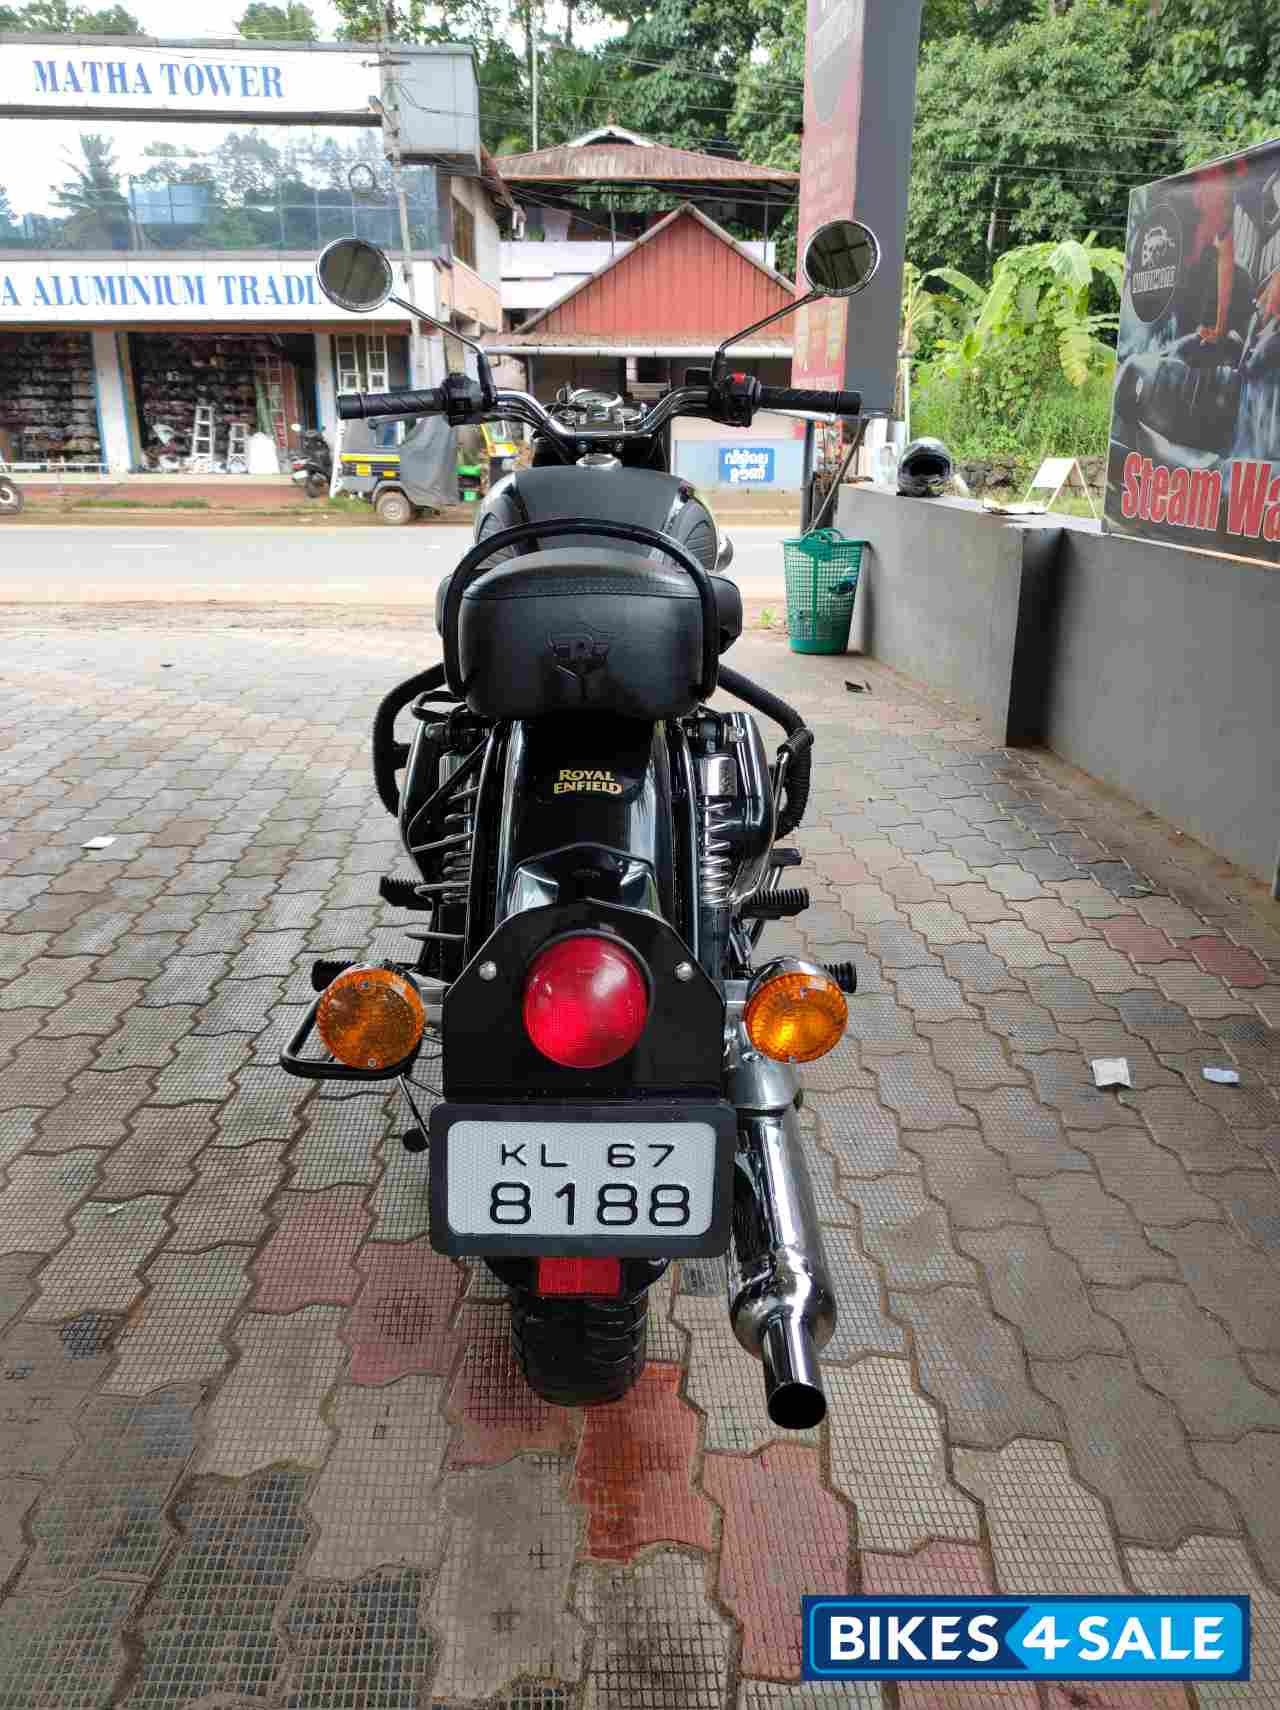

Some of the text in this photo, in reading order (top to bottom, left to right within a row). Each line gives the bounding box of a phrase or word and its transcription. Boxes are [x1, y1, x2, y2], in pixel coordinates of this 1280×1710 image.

[32, 60, 286, 98] MATHA TOWER
[33, 274, 208, 306] ALUMINIUM
[217, 274, 327, 306] TRADI
[1121, 451, 1222, 532] Steam
[553, 781, 624, 794] ENFIELD
[559, 769, 615, 782] ROYAL
[501, 1143, 675, 1168] KL 67
[489, 1181, 690, 1227] 8188
